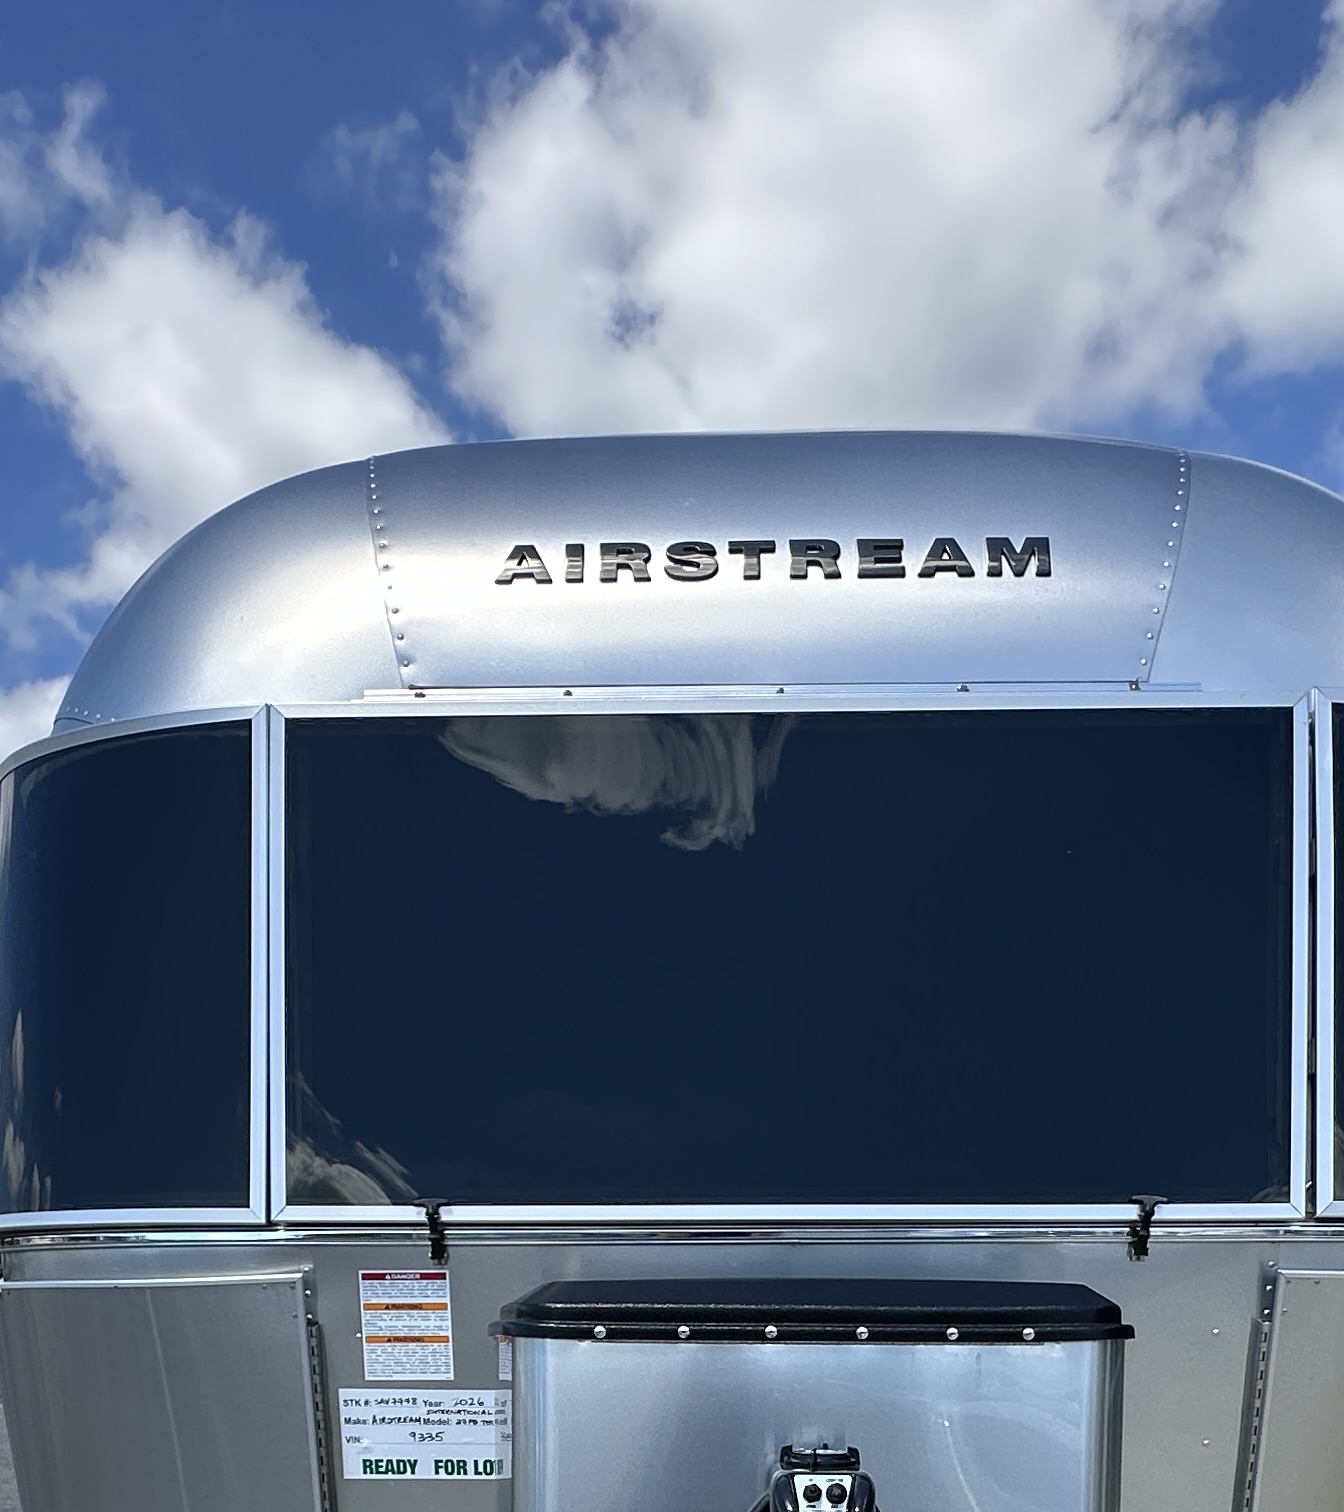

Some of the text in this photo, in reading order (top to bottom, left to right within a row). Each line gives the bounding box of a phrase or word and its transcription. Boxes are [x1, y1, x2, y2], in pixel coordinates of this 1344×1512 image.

[494, 536, 1052, 586] AIRSTREAM
[343, 1399, 362, 1407] STK
[451, 1396, 485, 1407] 2026
[372, 1414, 422, 1426] AIRSTREAM
[422, 1417, 452, 1426] Model:
[408, 1431, 446, 1443] 9335
[362, 1458, 418, 1475] READY
[434, 1459, 468, 1476] FOR
